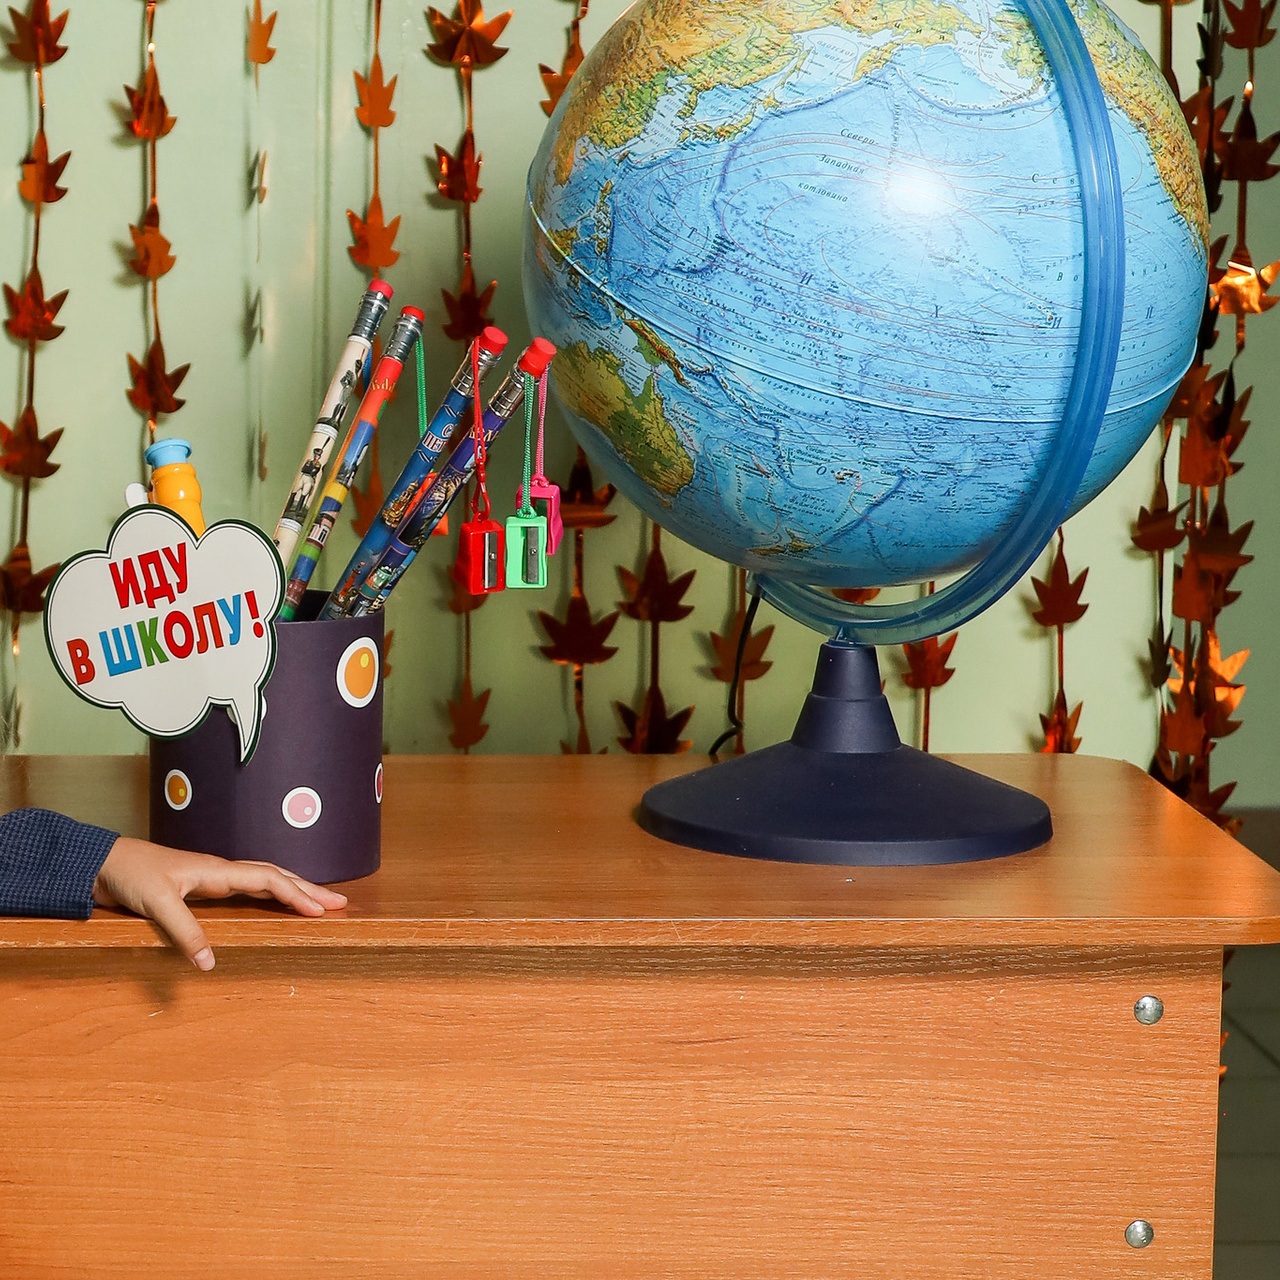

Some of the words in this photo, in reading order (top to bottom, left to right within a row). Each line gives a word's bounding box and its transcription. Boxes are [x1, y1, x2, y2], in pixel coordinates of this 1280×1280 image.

[840, 128, 880, 146] Северо-
[798, 182, 849, 203] котловина
[108, 541, 188, 609] ИДУ
[66, 638, 96, 685] В
[98, 590, 264, 677] ШКОЛУ!
